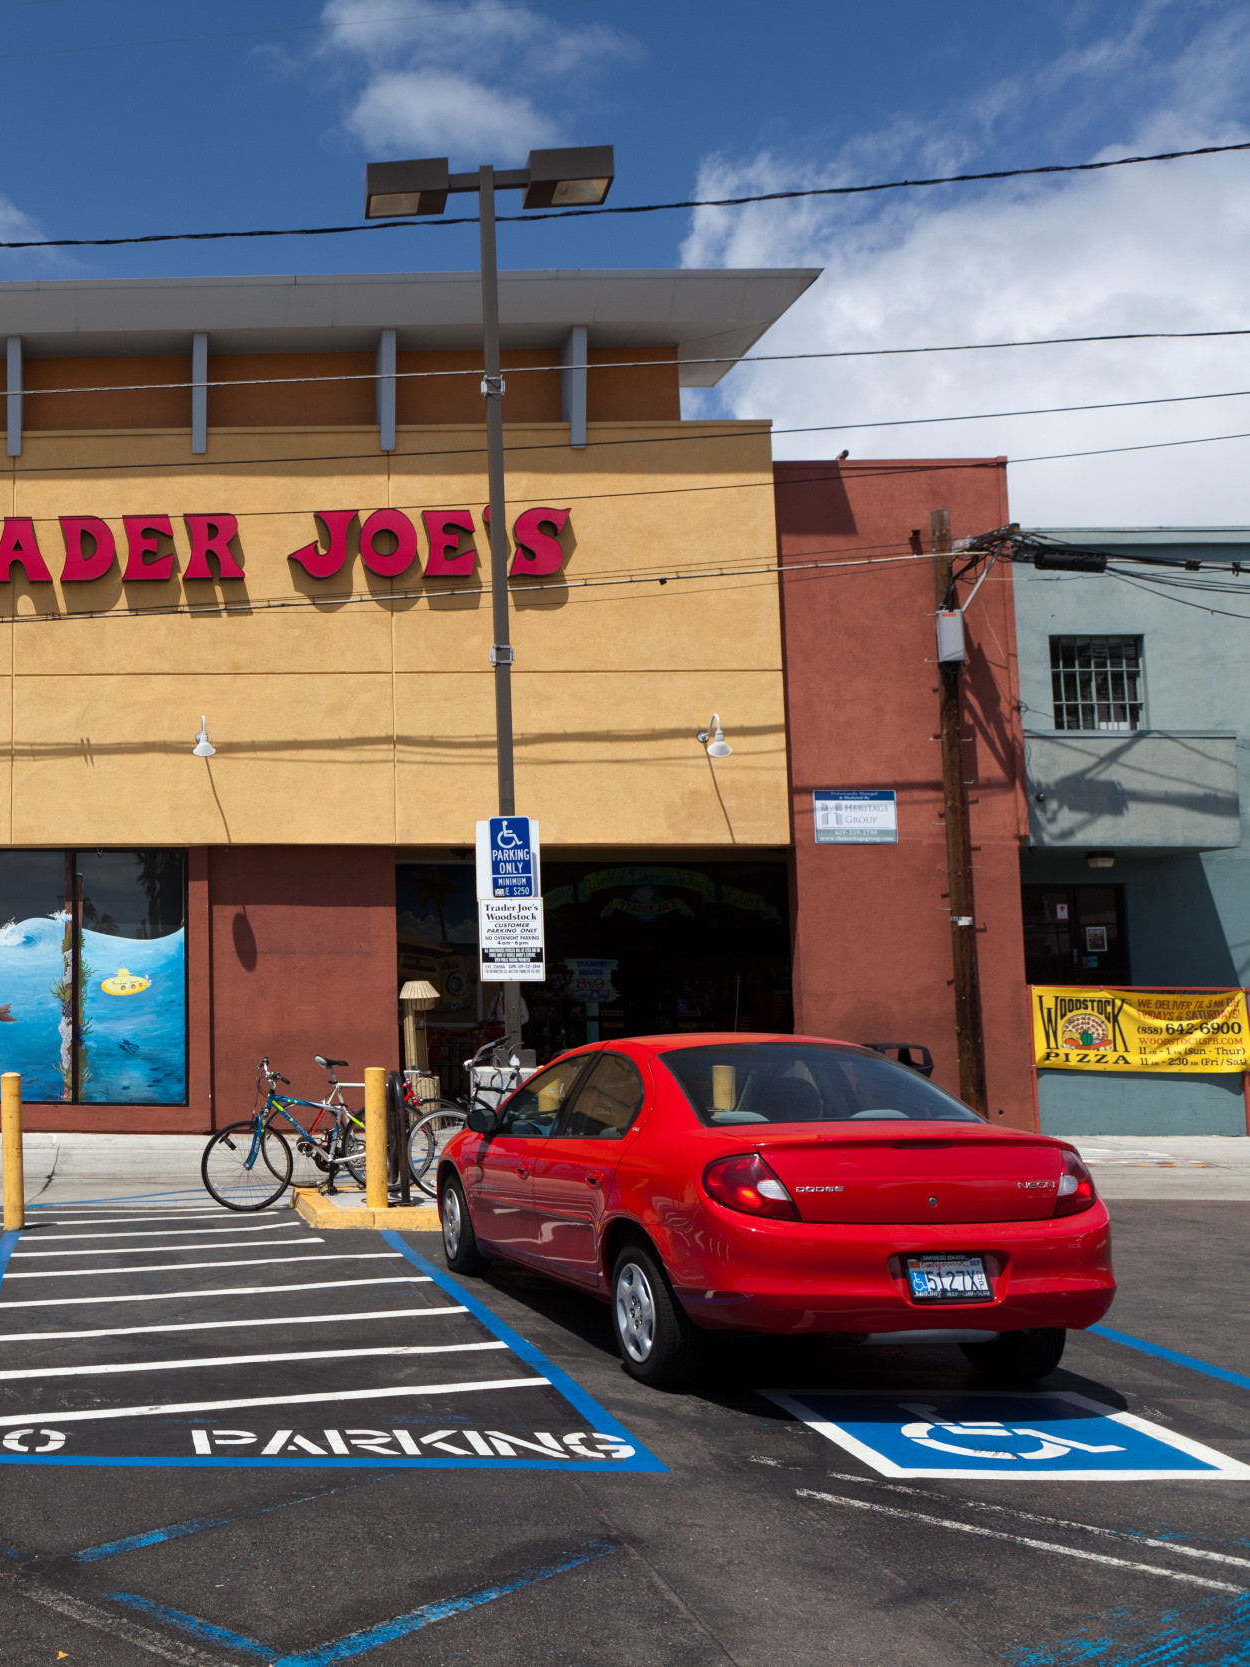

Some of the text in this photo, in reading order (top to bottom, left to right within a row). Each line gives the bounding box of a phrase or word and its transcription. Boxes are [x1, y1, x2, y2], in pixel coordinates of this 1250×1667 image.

[845, 804, 889, 813] HERITAGE
[844, 816, 878, 824] GROUP
[492, 849, 530, 861] PARKING
[499, 862, 523, 874] ONLY
[498, 877, 527, 886] MINIMUM
[513, 886, 530, 896] $250
[484, 903, 538, 913] Trader Joe's
[620, 901, 653, 914] TRADER
[1138, 999, 1152, 1008] WE
[1156, 999, 1192, 1010] DELIVER
[1138, 1008, 1240, 1020] FRIDAYS & SATURDAYS!
[1137, 1021, 1242, 1035] (858) 642-6900
[1184, 1047, 1206, 1055] (Sun
[1214, 1047, 1246, 1055] Thur)
[1044, 1052, 1131, 1065] PIZZA
[1017, 1181, 1056, 1189] NEON
[925, 1270, 979, 1292] 5127X
[191, 1429, 636, 1459] PARKING
